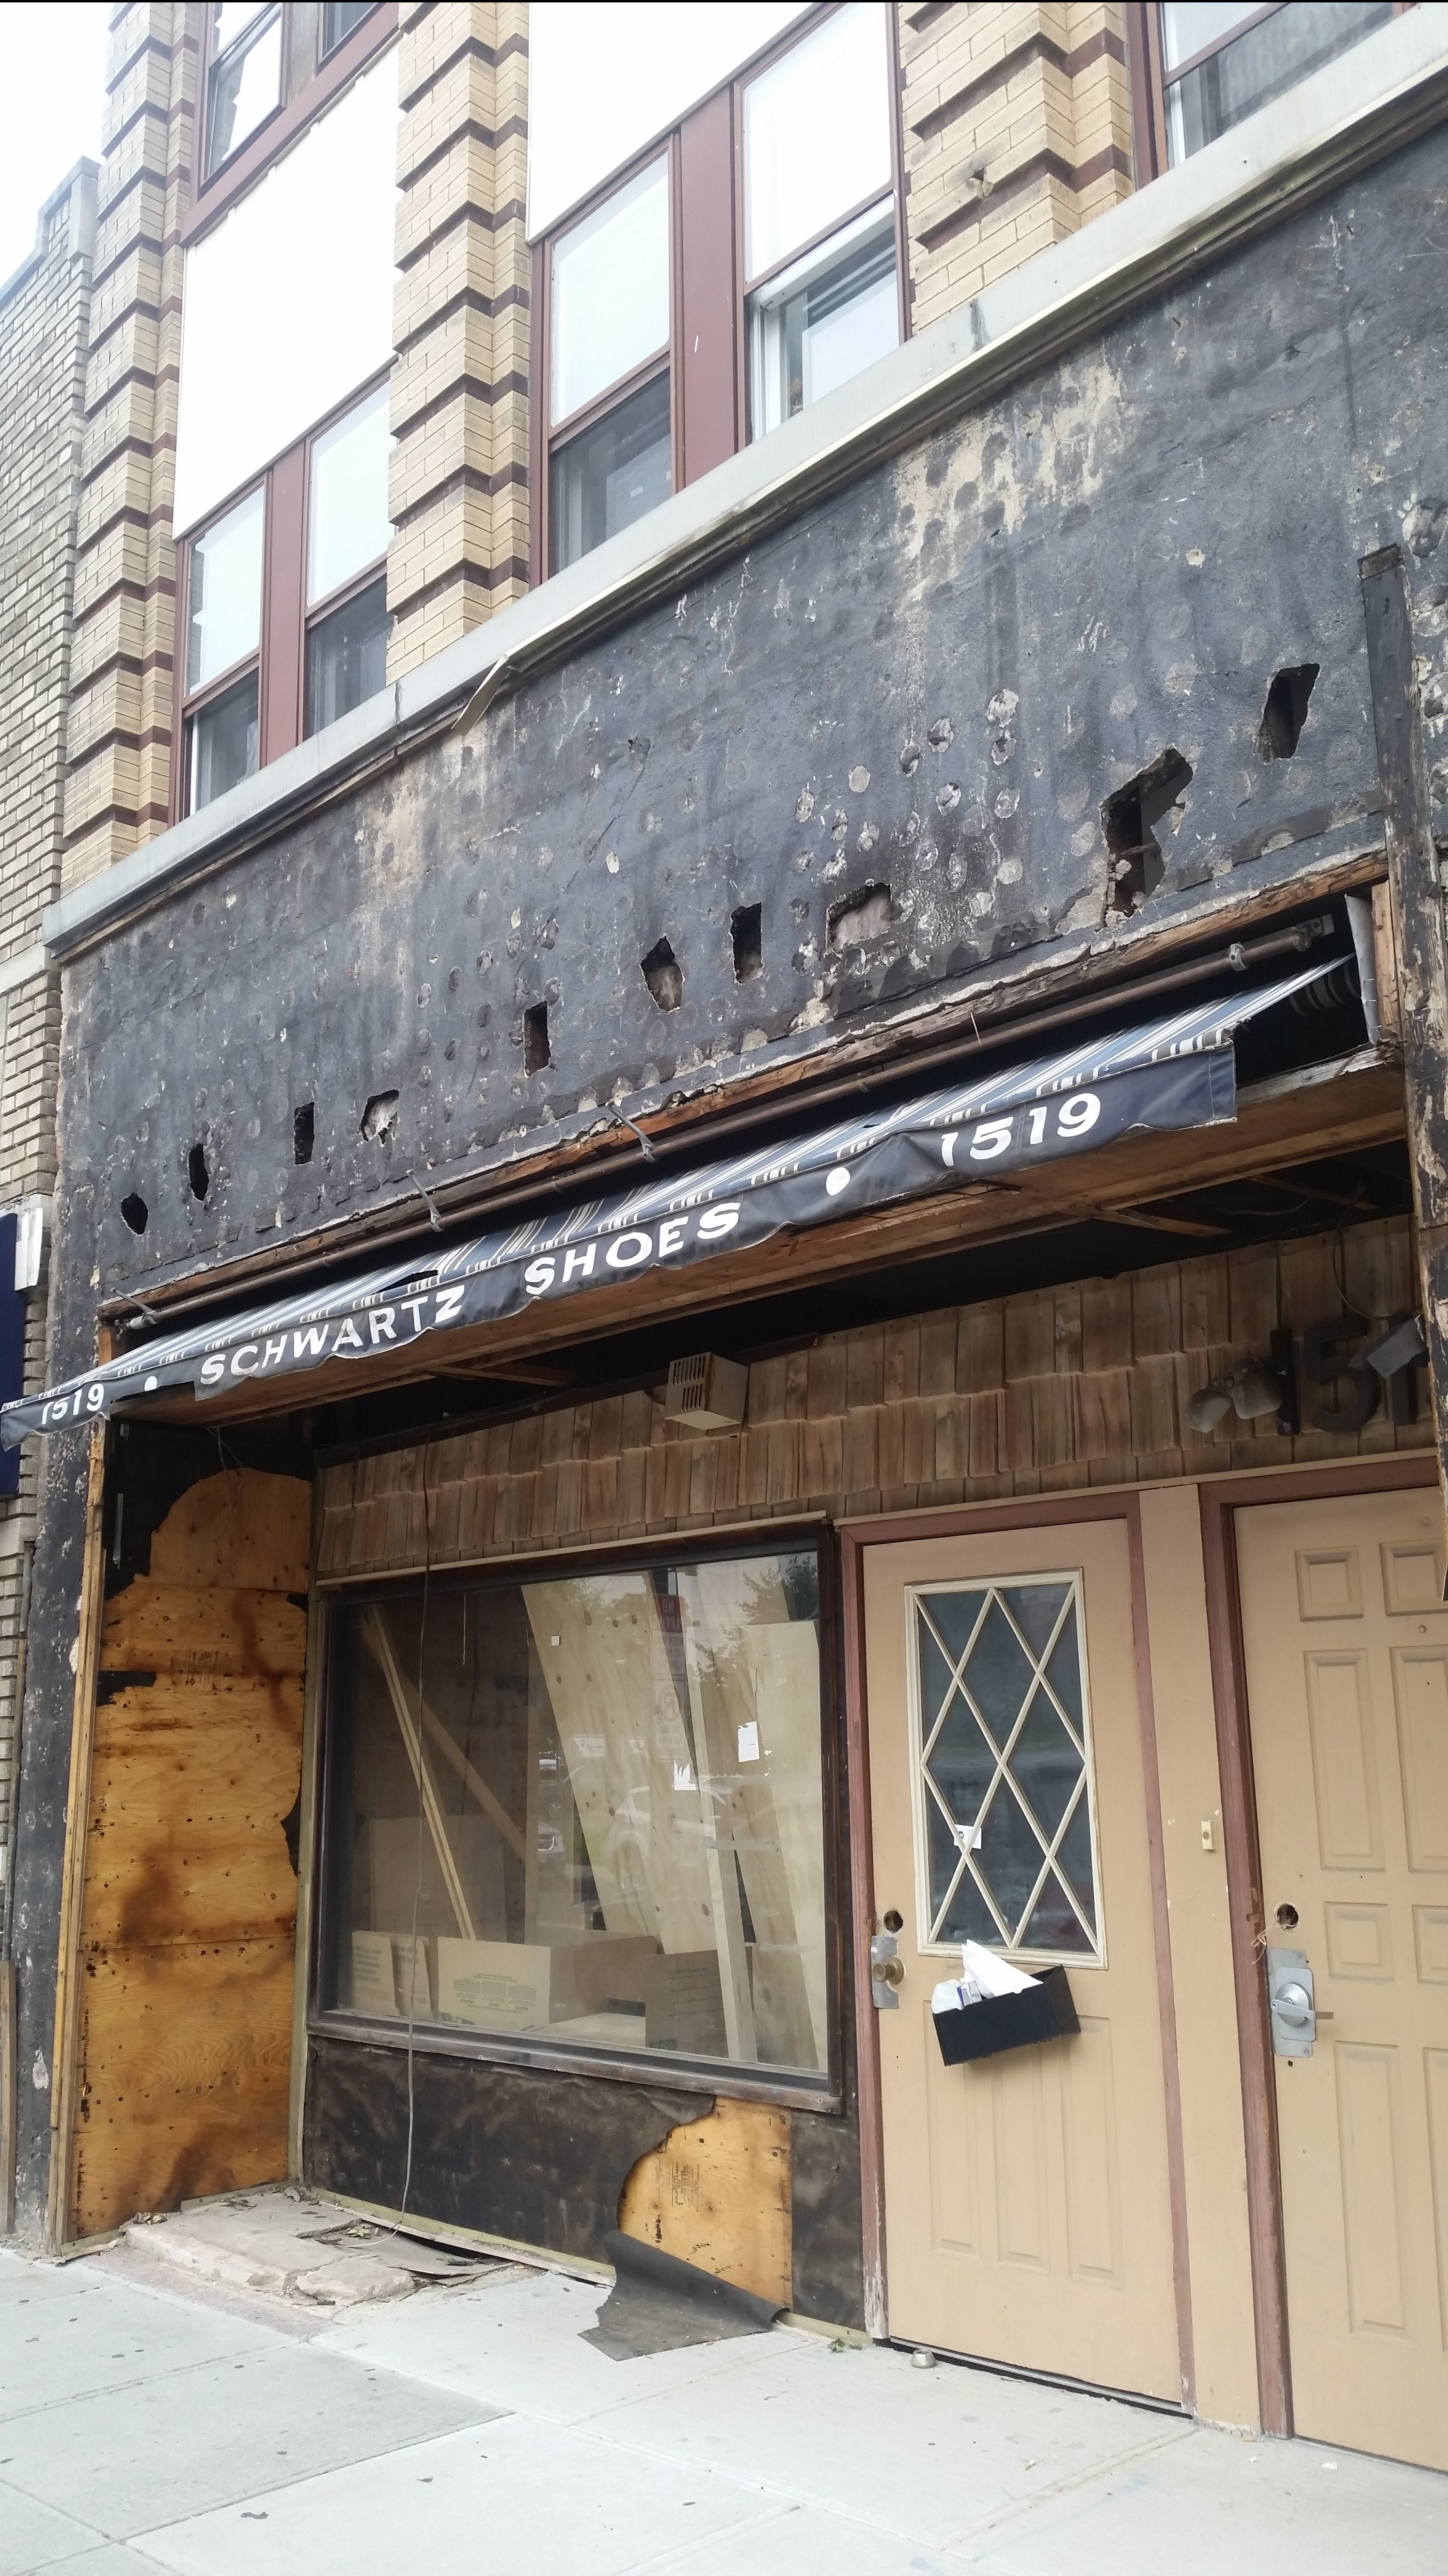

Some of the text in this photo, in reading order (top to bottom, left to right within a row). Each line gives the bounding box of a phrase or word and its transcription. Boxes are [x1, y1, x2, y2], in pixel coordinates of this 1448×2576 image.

[42, 1093, 1101, 1424] 1519 SCHWARTZ SHOES 1519
